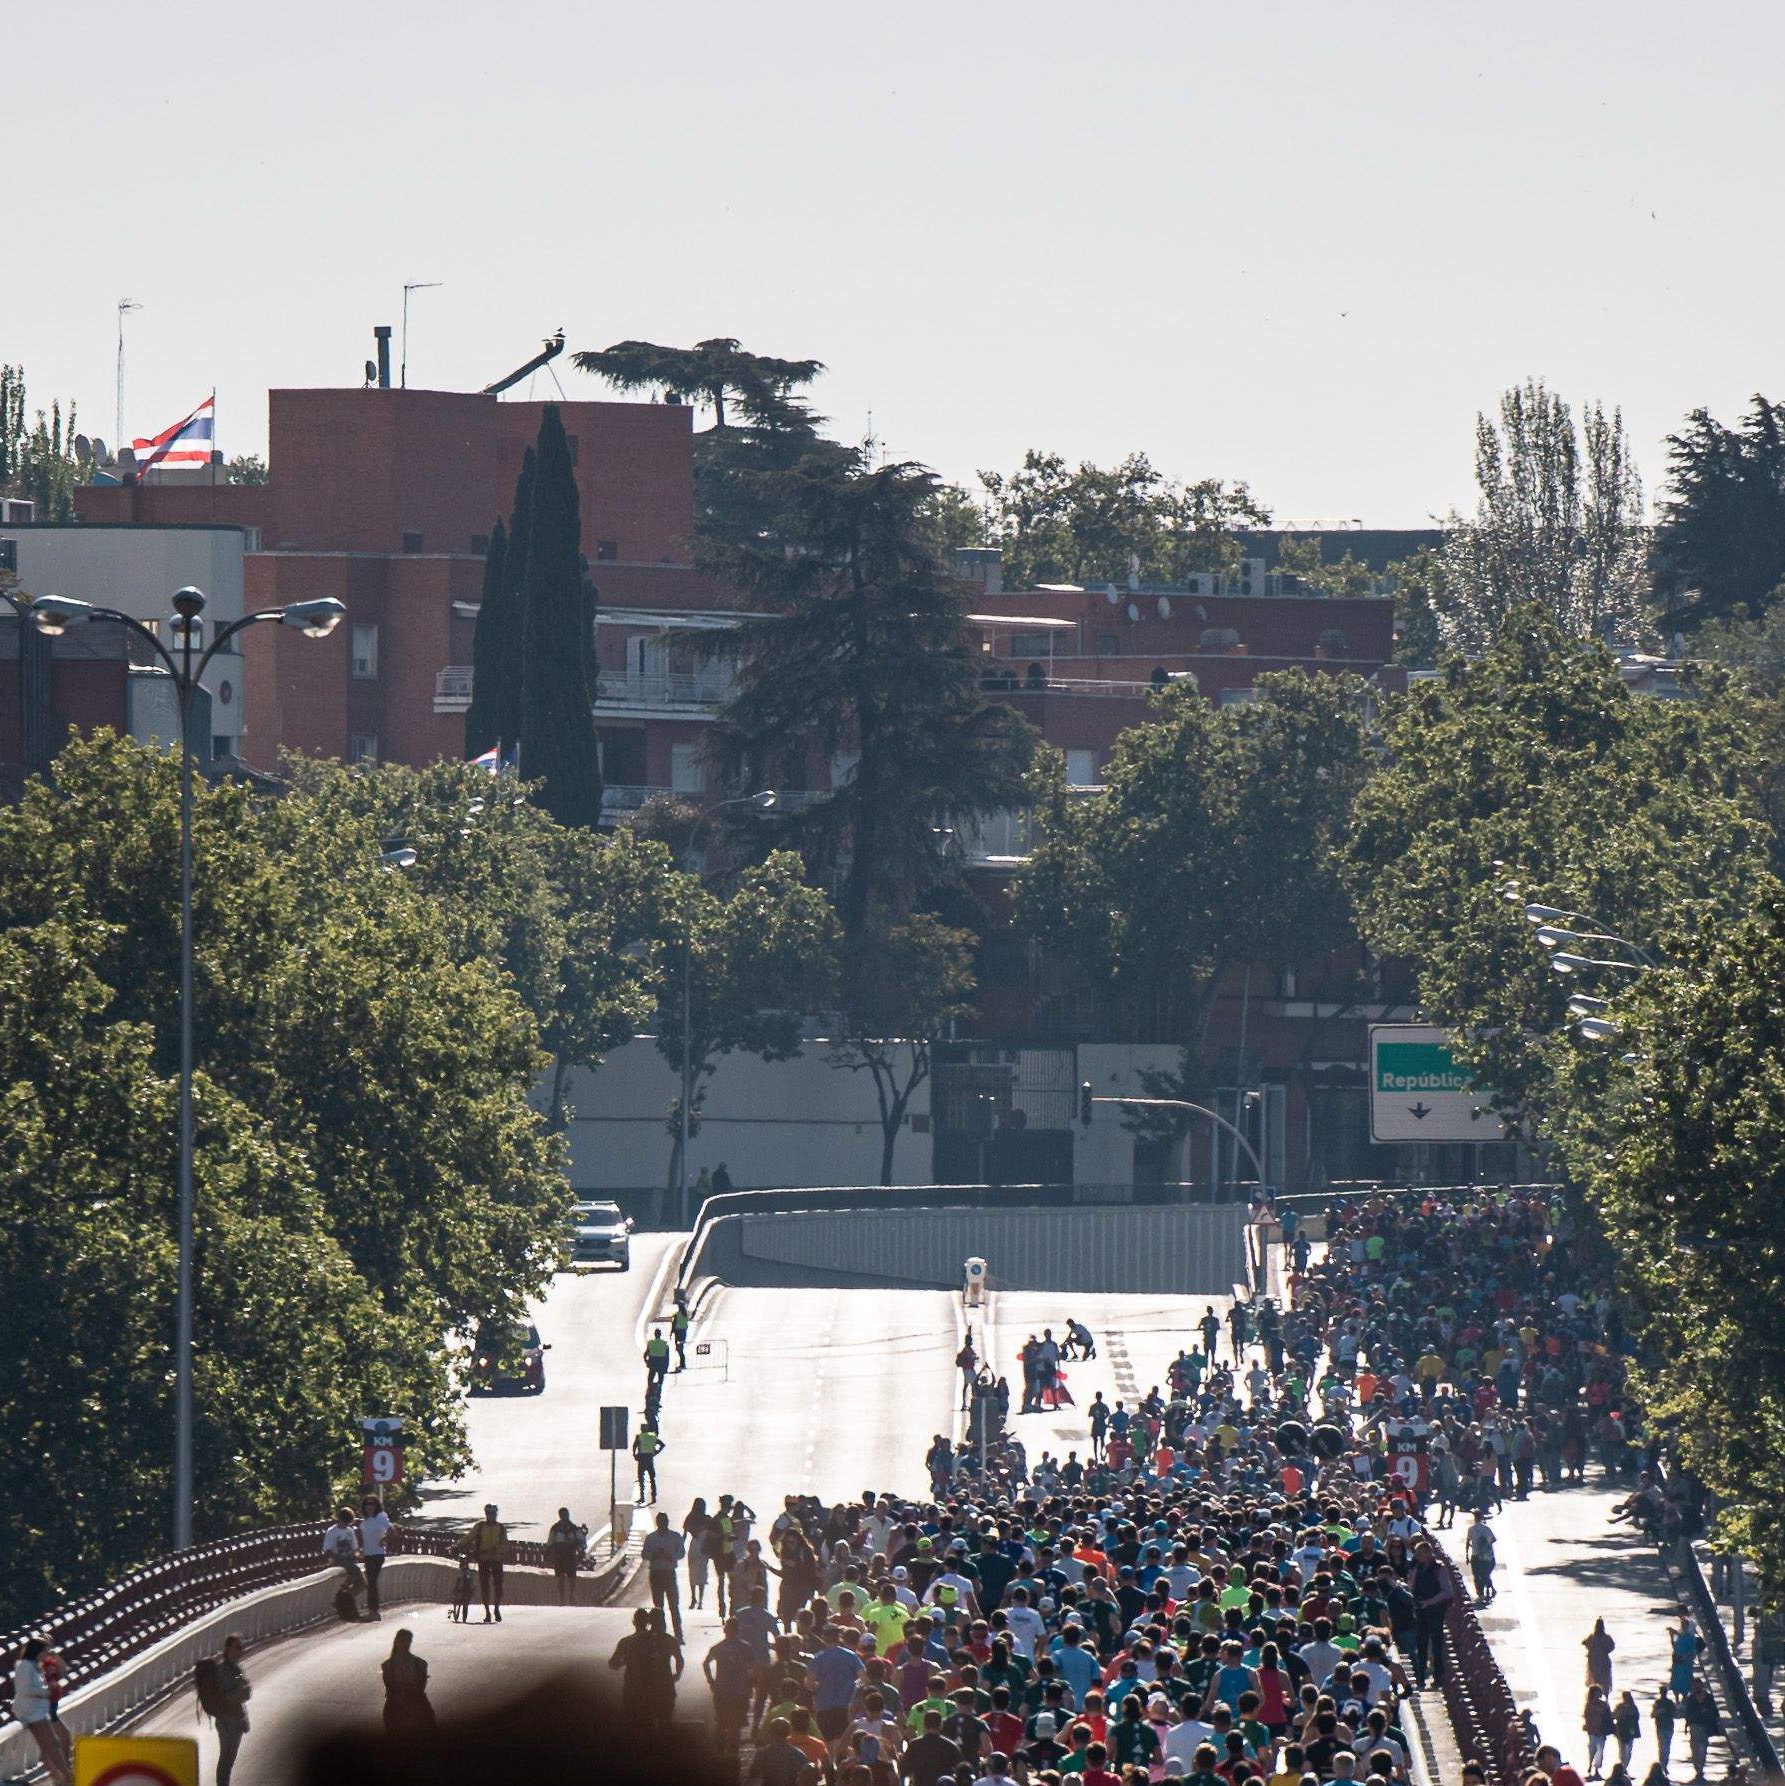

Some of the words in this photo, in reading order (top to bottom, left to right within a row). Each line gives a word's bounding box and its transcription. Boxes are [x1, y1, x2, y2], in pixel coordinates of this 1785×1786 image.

[1397, 1442, 1417, 1452] KM
[372, 1450, 394, 1481] 9
[1396, 1456, 1418, 1489] 9
